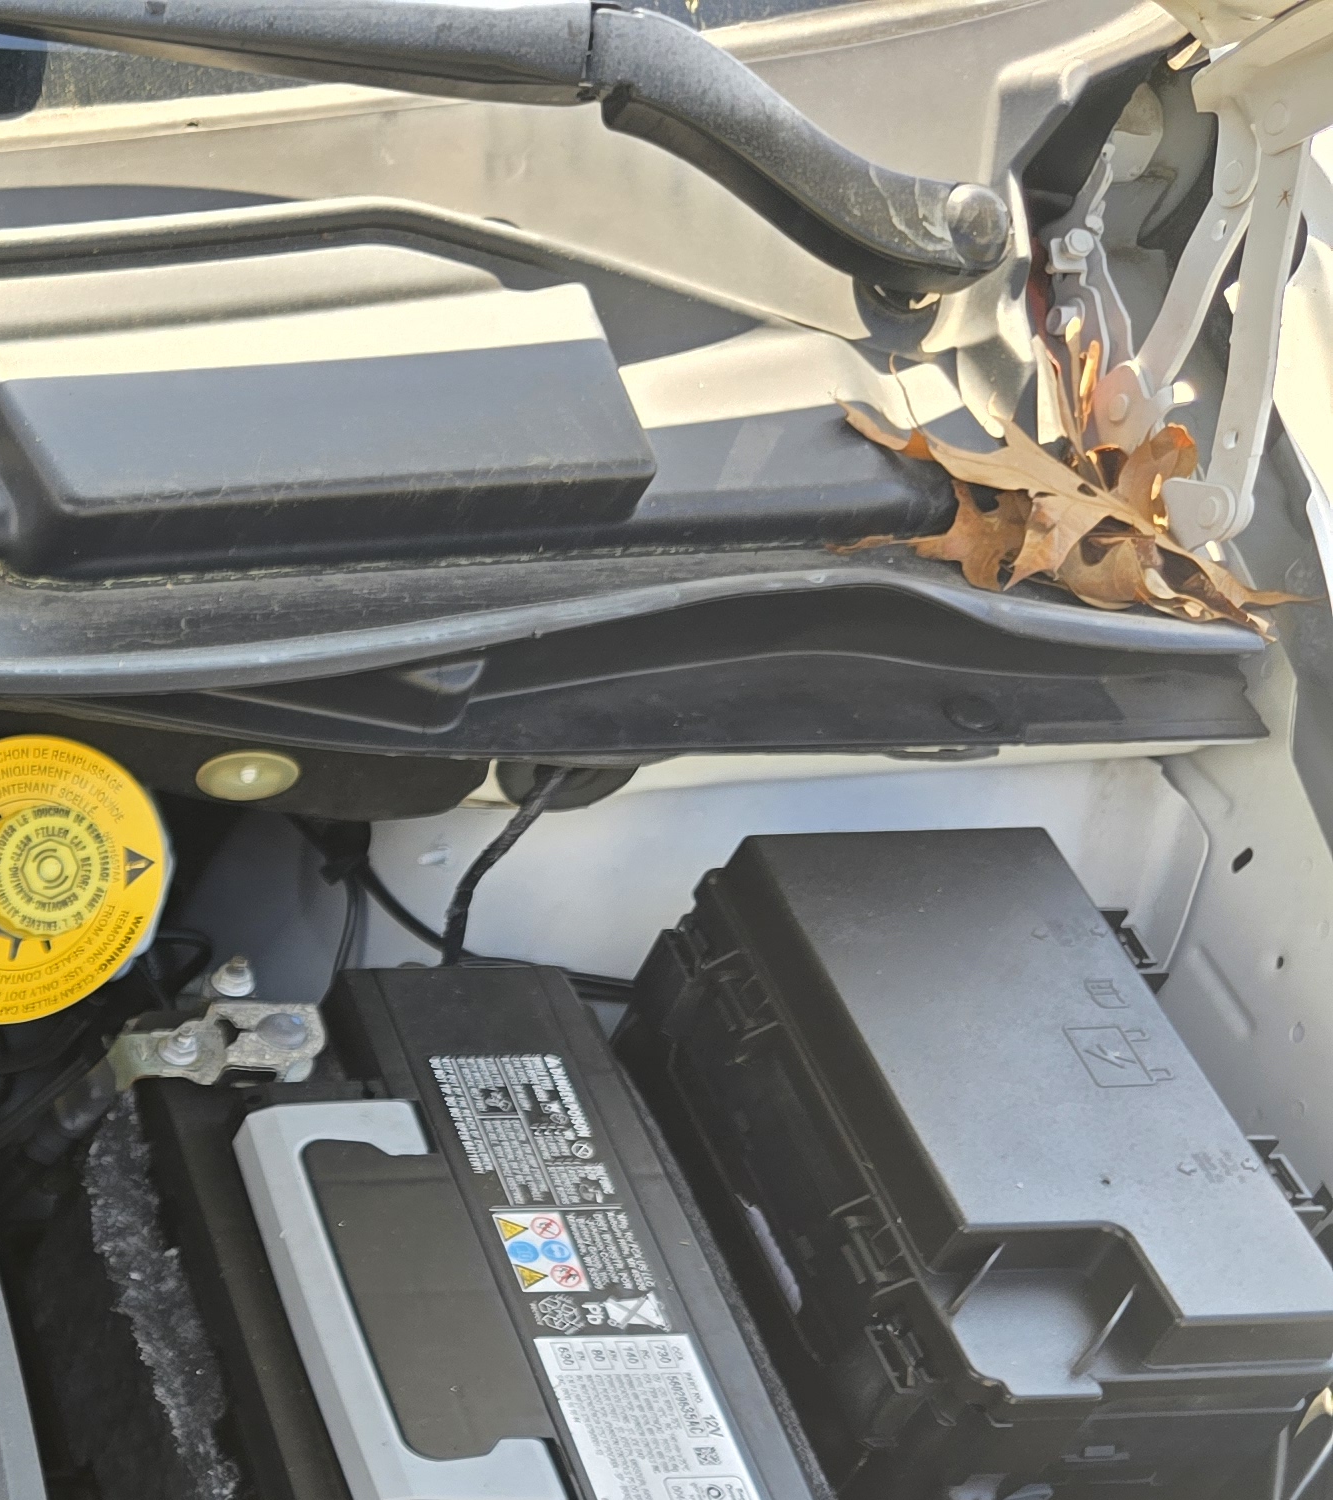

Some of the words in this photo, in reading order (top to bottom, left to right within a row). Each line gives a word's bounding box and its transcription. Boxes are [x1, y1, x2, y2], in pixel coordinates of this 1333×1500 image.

[32, 747, 51, 760] DE
[580, 1303, 607, 1324] Pb
[622, 1346, 640, 1364] 140
[652, 1344, 672, 1364] 730
[700, 1414, 723, 1437] 12V
